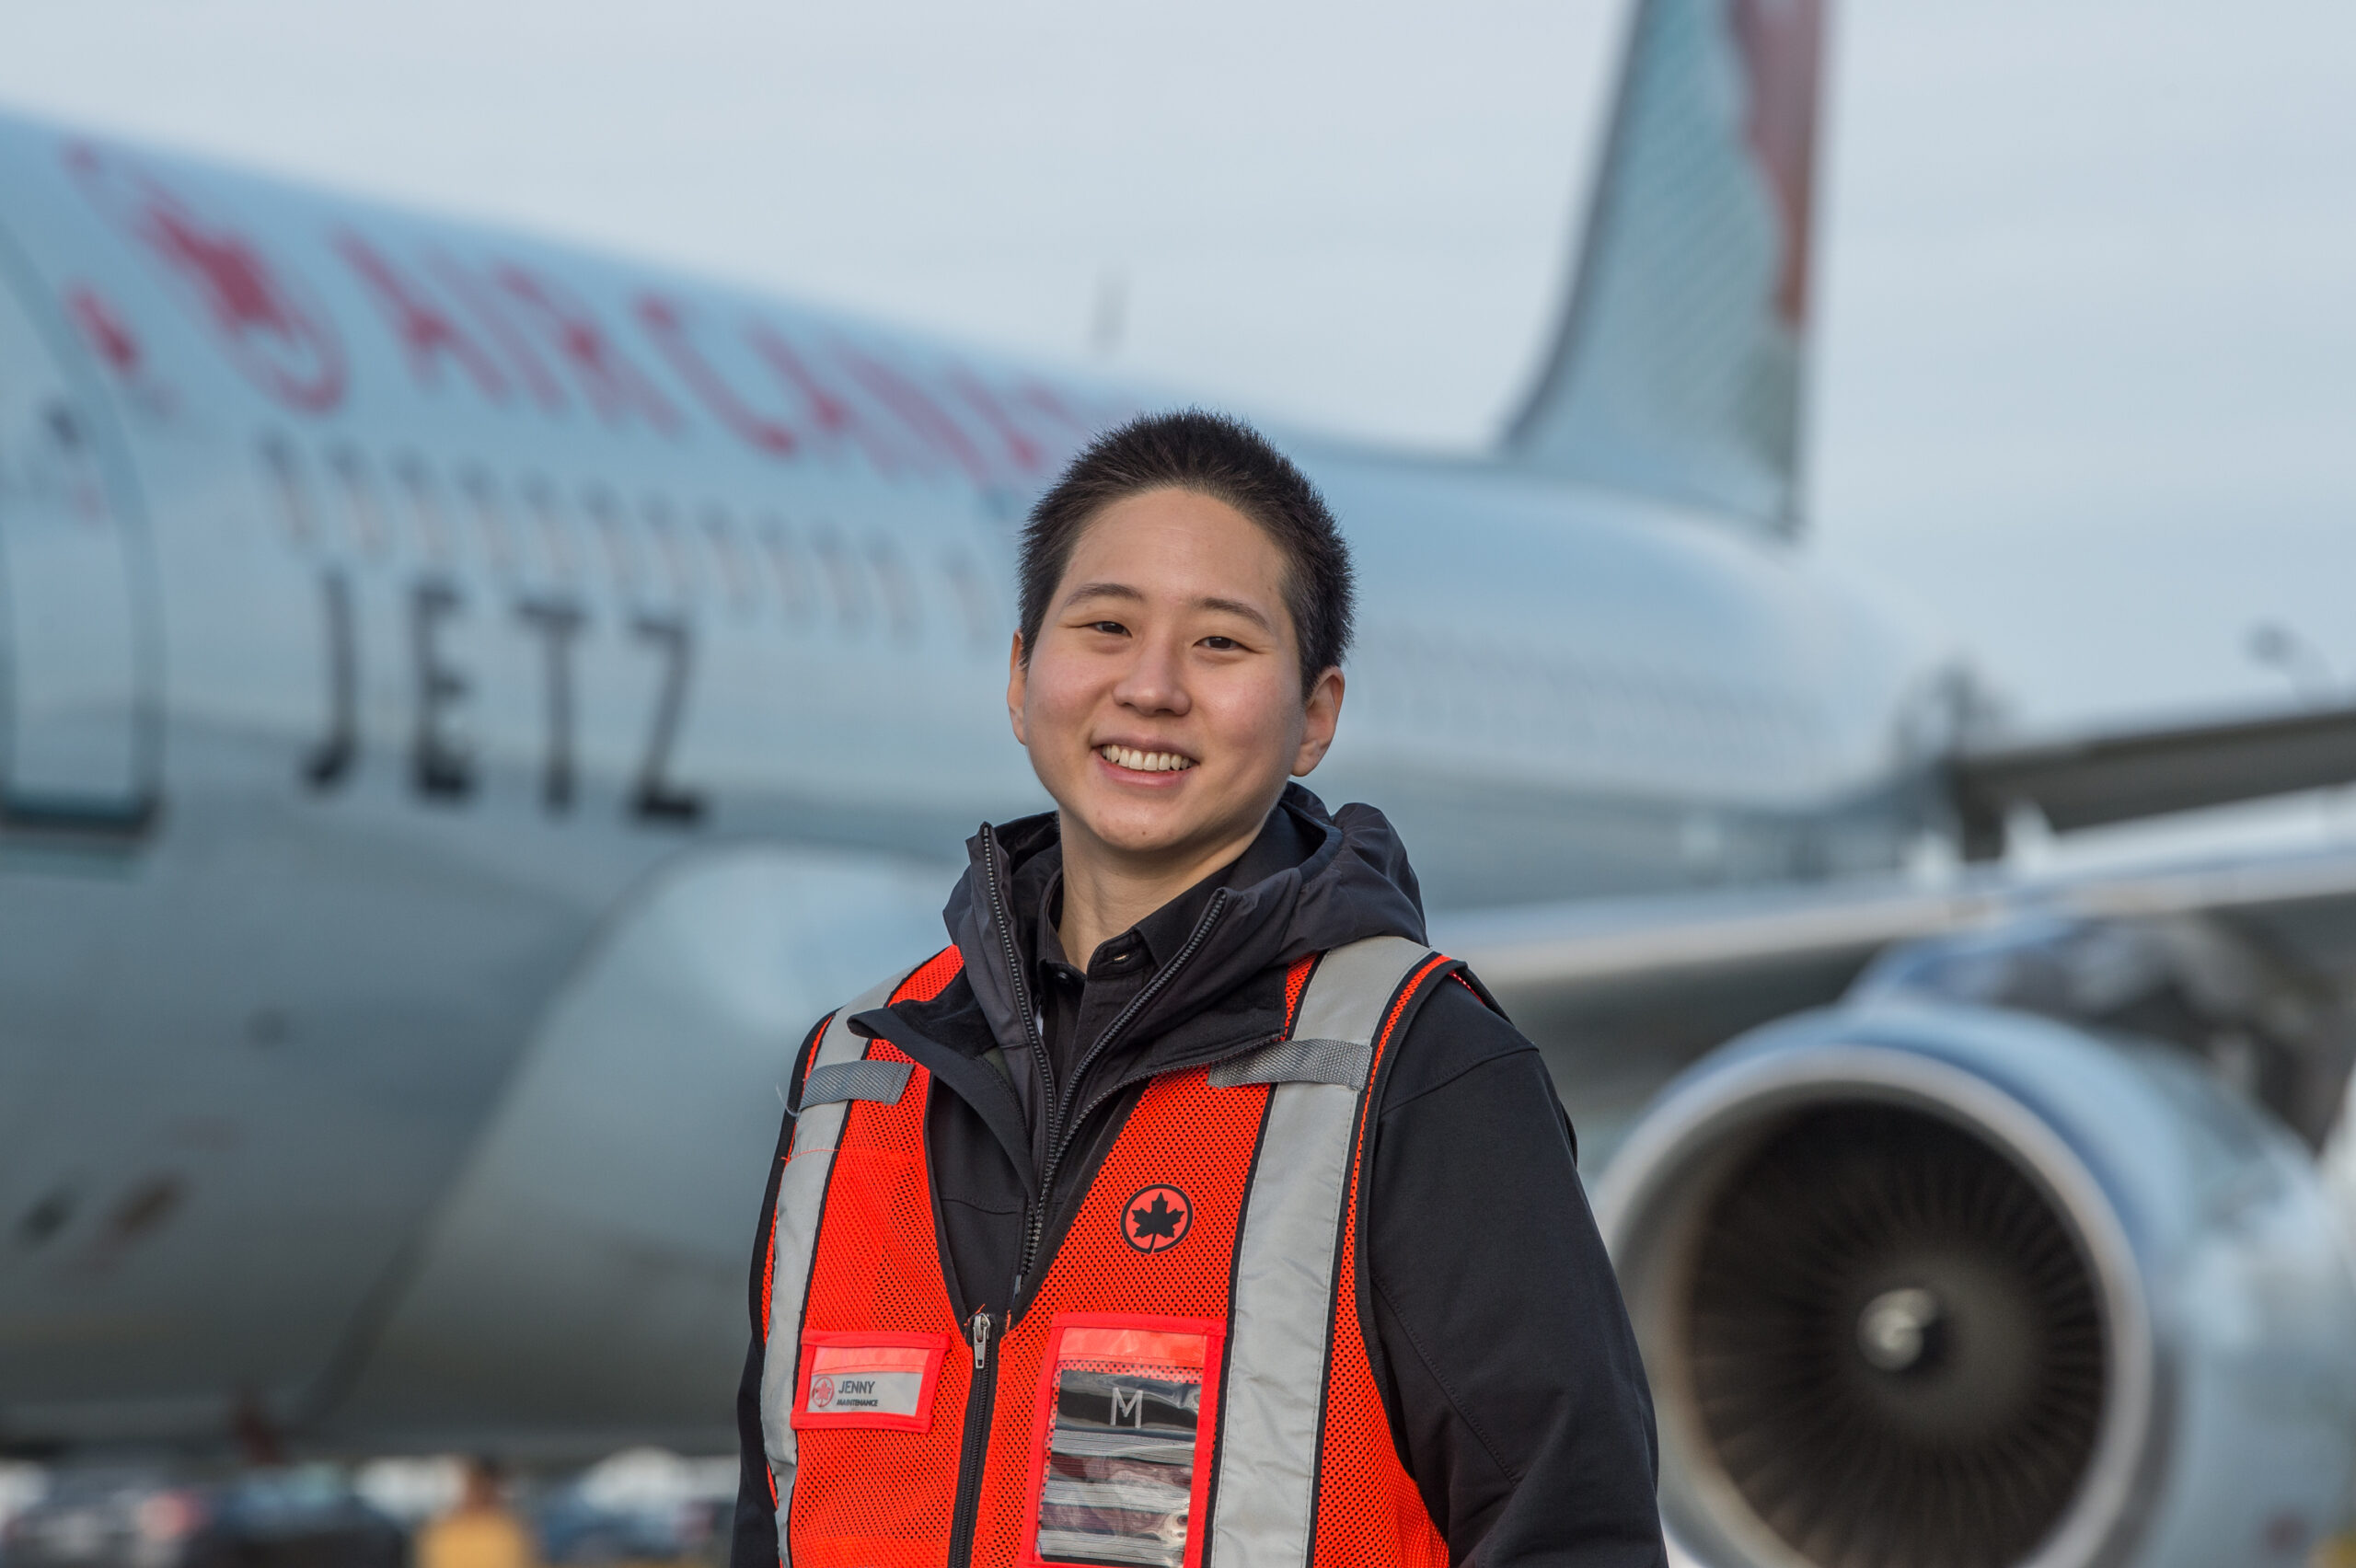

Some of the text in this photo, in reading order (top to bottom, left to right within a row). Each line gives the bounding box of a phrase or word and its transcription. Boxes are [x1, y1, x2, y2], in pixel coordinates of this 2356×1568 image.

[328, 223, 687, 444] AIR
[302, 565, 710, 826] JETZ
[837, 1399, 878, 1407] MAINTENANCE
[838, 1380, 875, 1394] JENNY
[1111, 1387, 1143, 1429] M
